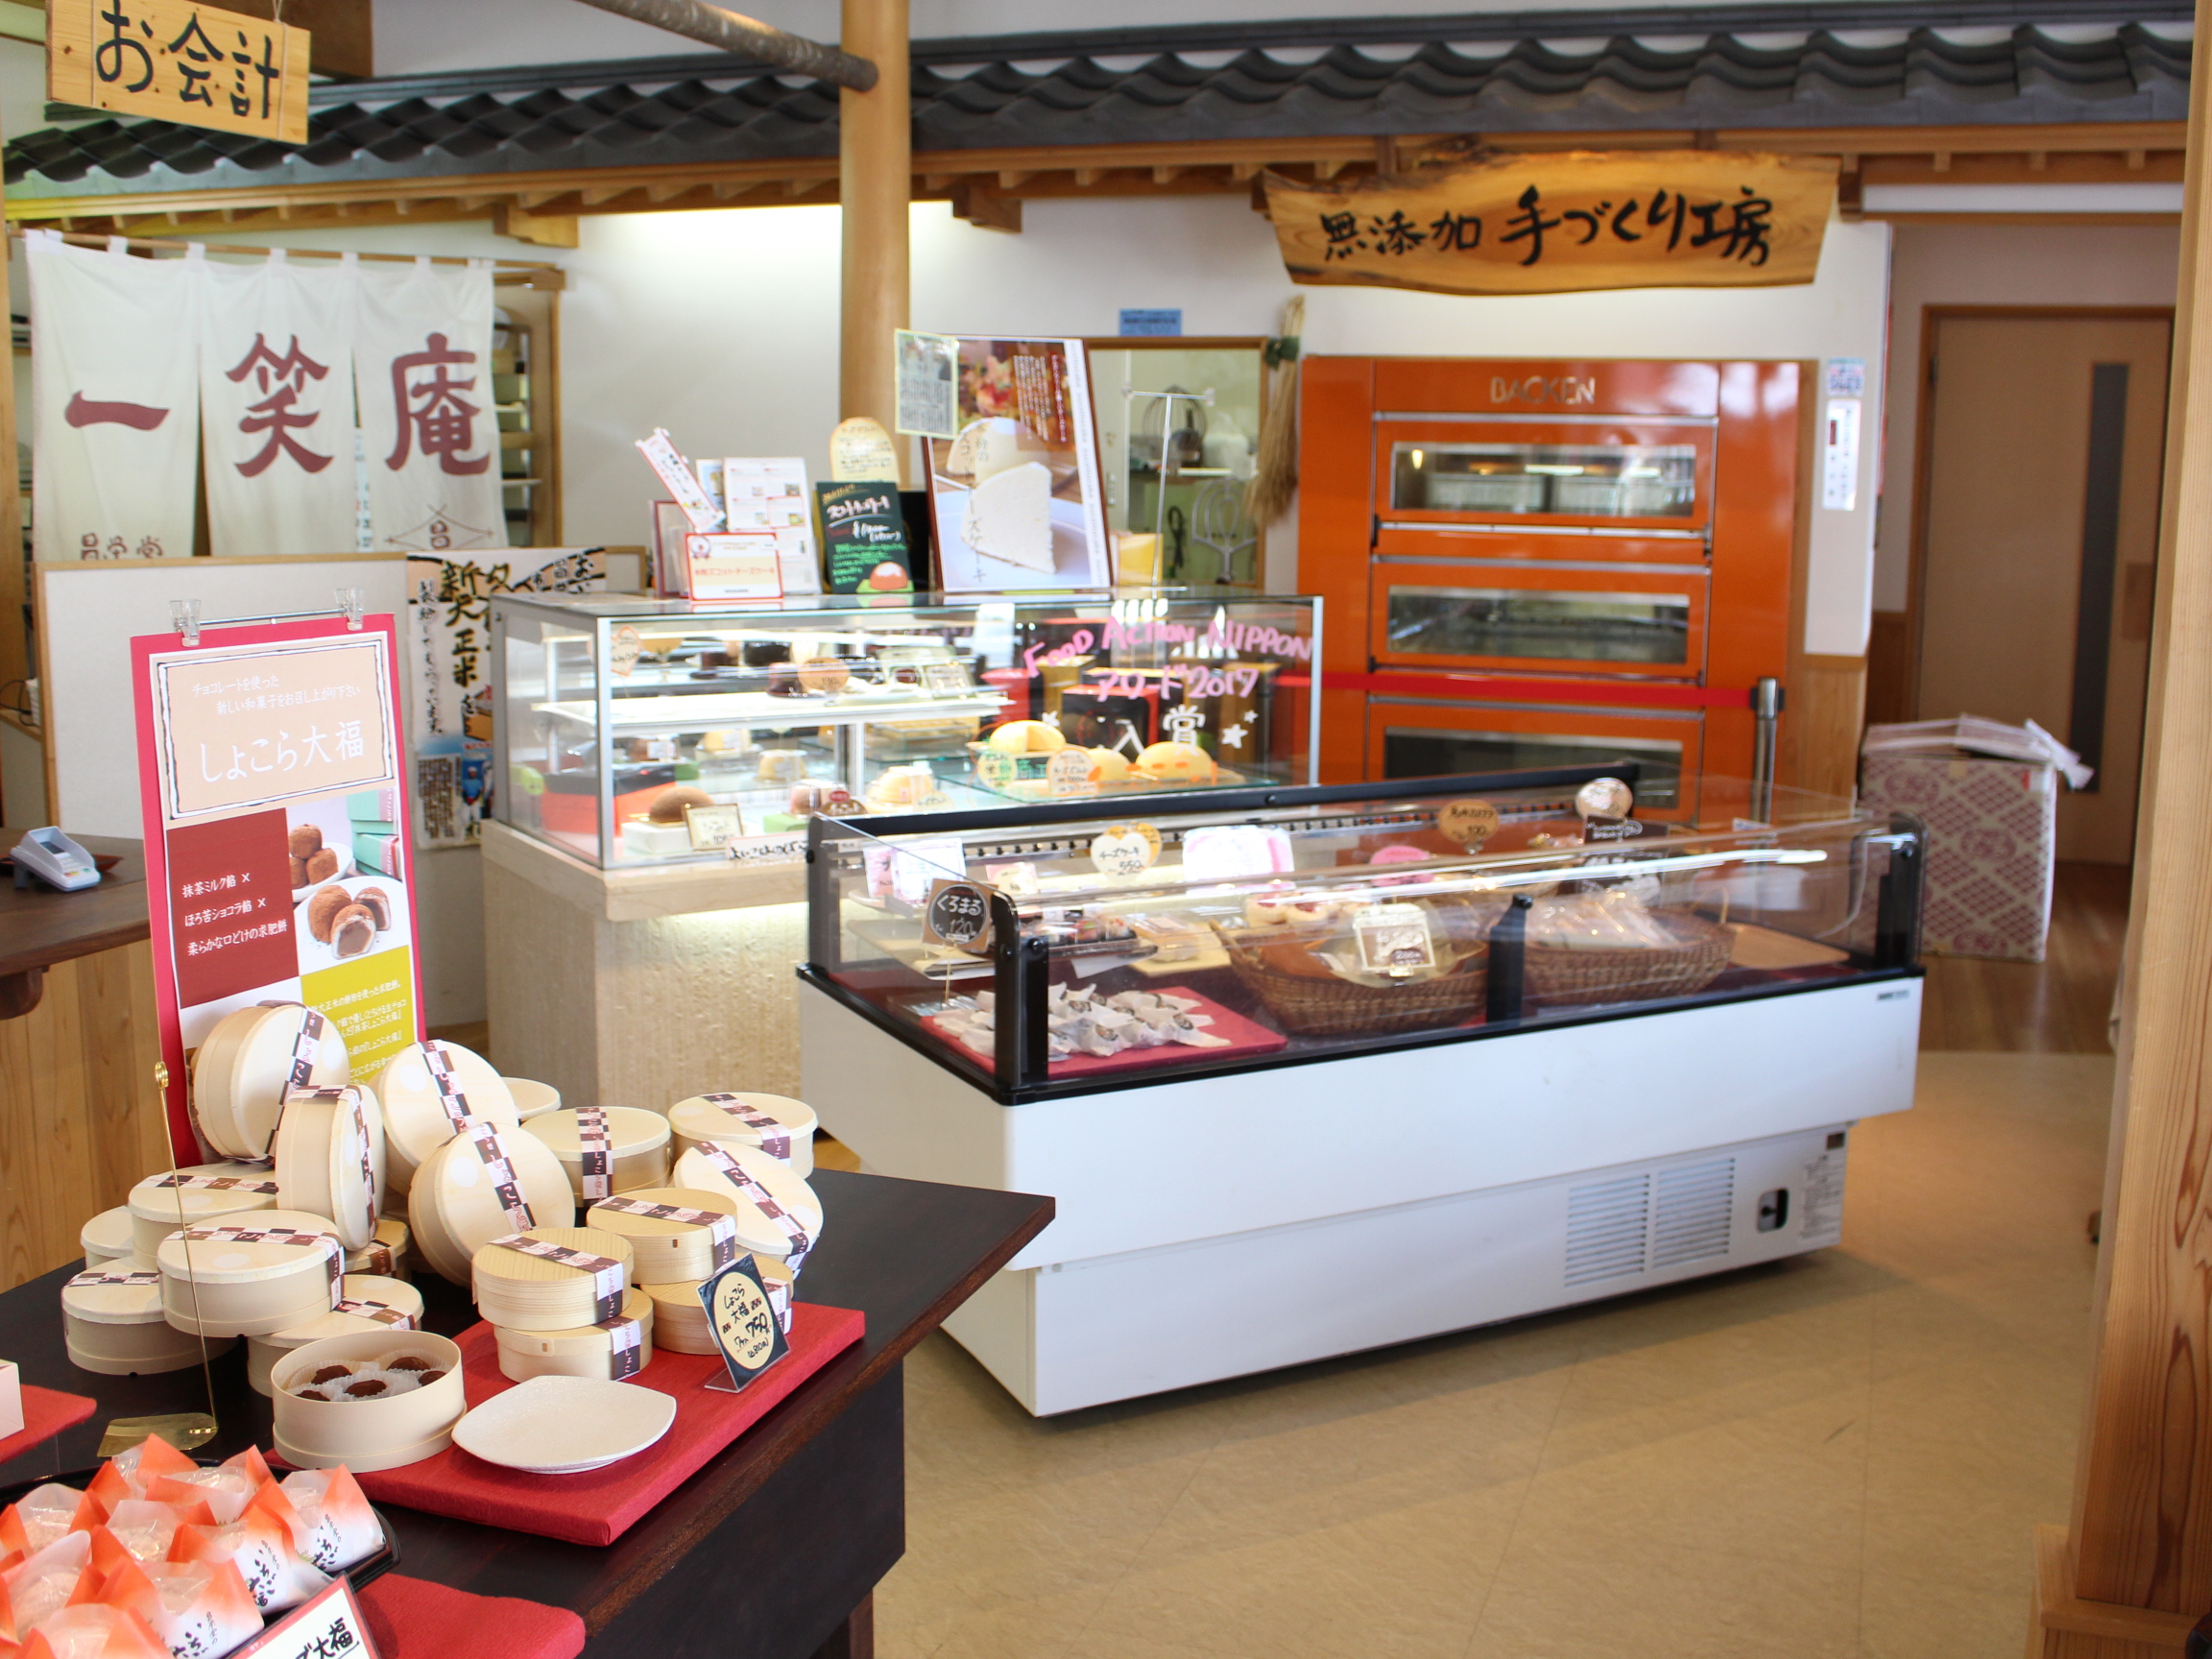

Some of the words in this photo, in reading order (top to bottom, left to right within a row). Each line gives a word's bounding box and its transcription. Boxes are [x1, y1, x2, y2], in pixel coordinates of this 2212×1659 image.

[96, 0, 280, 121] お会計
[1319, 208, 1482, 260] 無添加
[1499, 183, 1774, 267] 手づくり工房
[63, 331, 492, 478] 一笑庵
[1490, 375, 1596, 406] BACKEN
[191, 673, 280, 699] チョコレートを使った
[216, 684, 362, 716] 新しい和菓子をお召し上がり下さい
[1108, 704, 1207, 757] 入賞
[200, 719, 366, 783] しょこら大福
[182, 874, 237, 899] 抹茶ミルク餡
[184, 899, 252, 927] ほろ苦ショコラ餡
[936, 893, 982, 916] くろまる
[187, 918, 288, 956] 柔らかな口どけの求肥餅
[724, 1283, 746, 1310] しょこら
[730, 1301, 751, 1325] 大福
